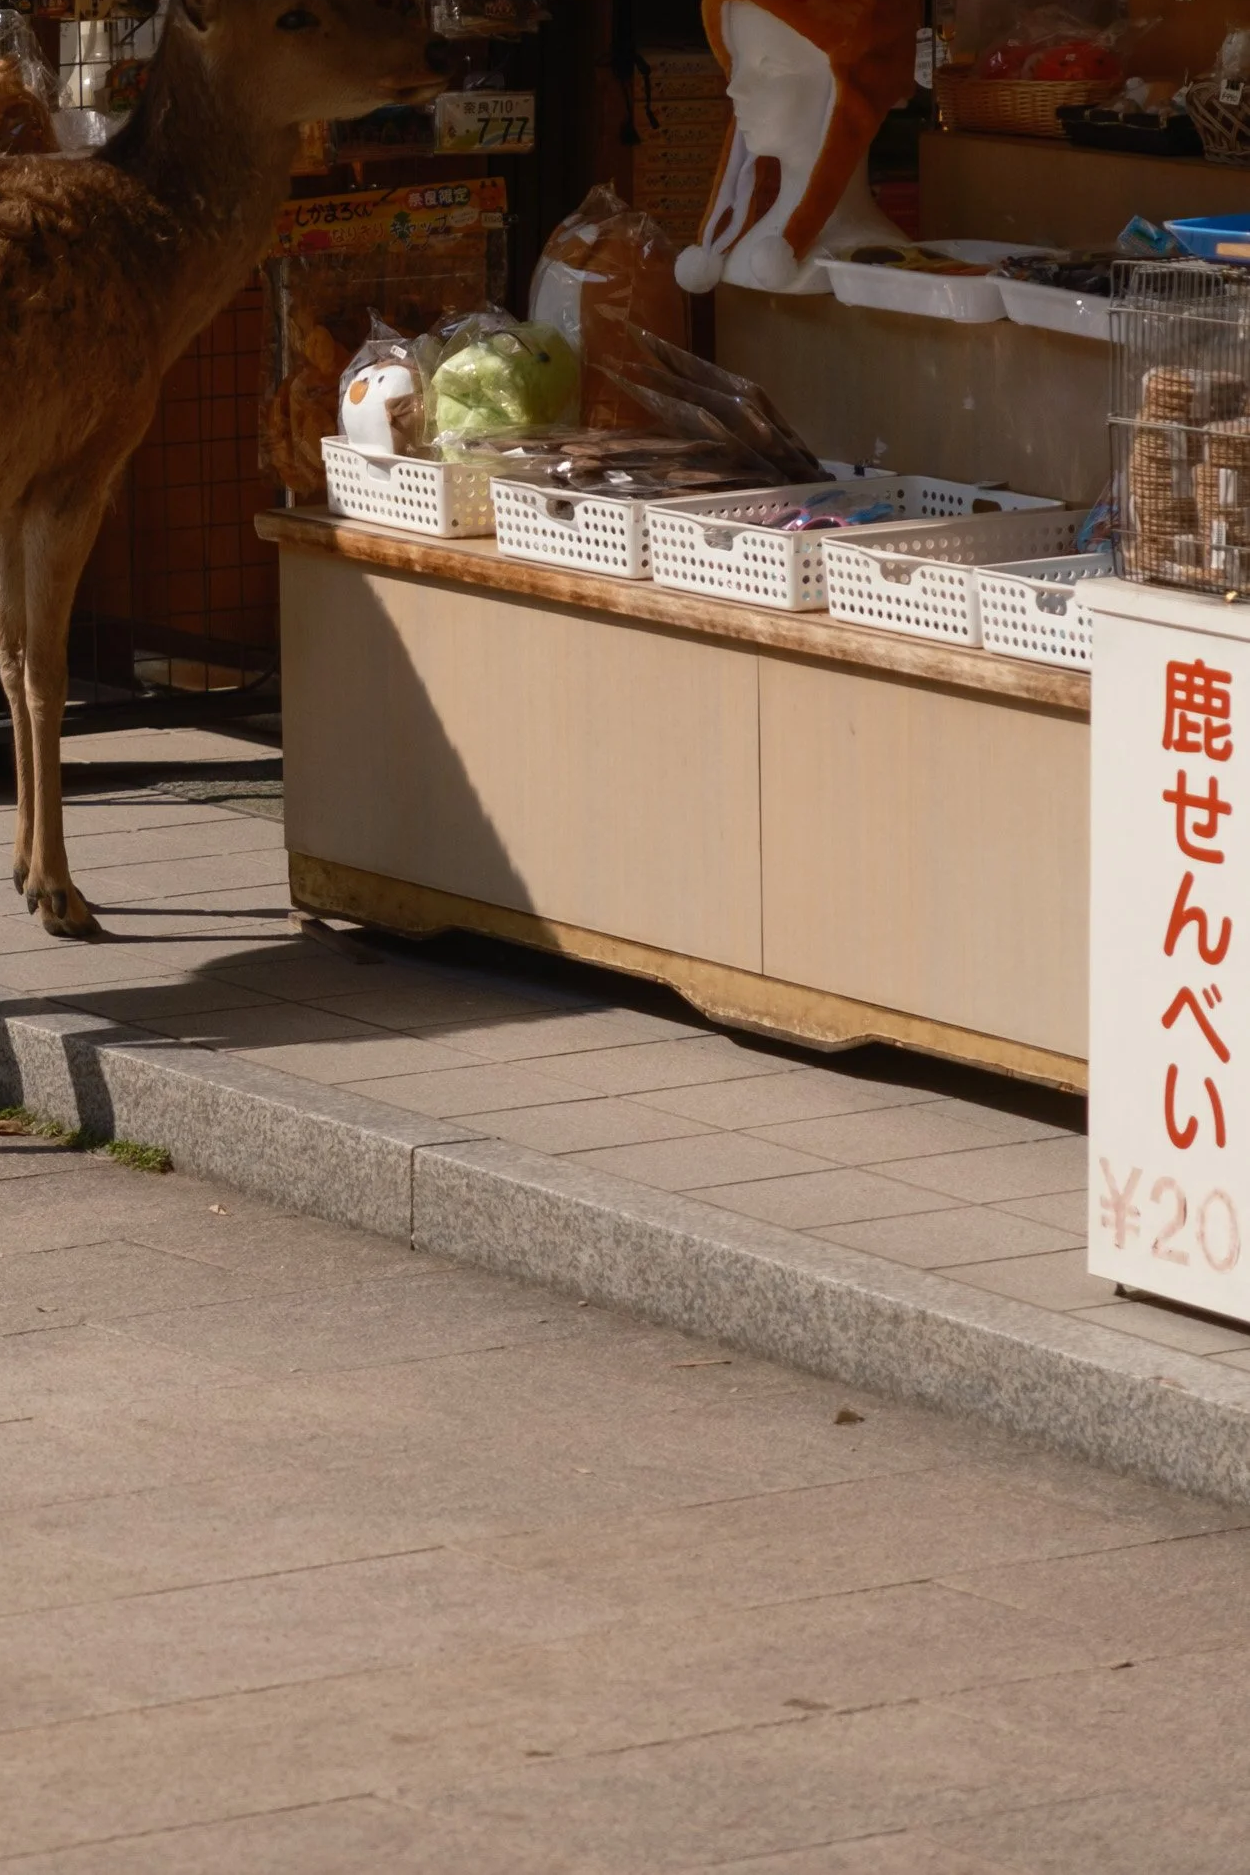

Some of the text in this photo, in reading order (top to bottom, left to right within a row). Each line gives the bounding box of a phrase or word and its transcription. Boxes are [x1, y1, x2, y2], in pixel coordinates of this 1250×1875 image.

[463, 99, 513, 115] 奈良710
[406, 186, 470, 209] 奈良限定
[295, 201, 374, 227] しかまろくん
[1160, 659, 1235, 1151] 鹿せんべい
